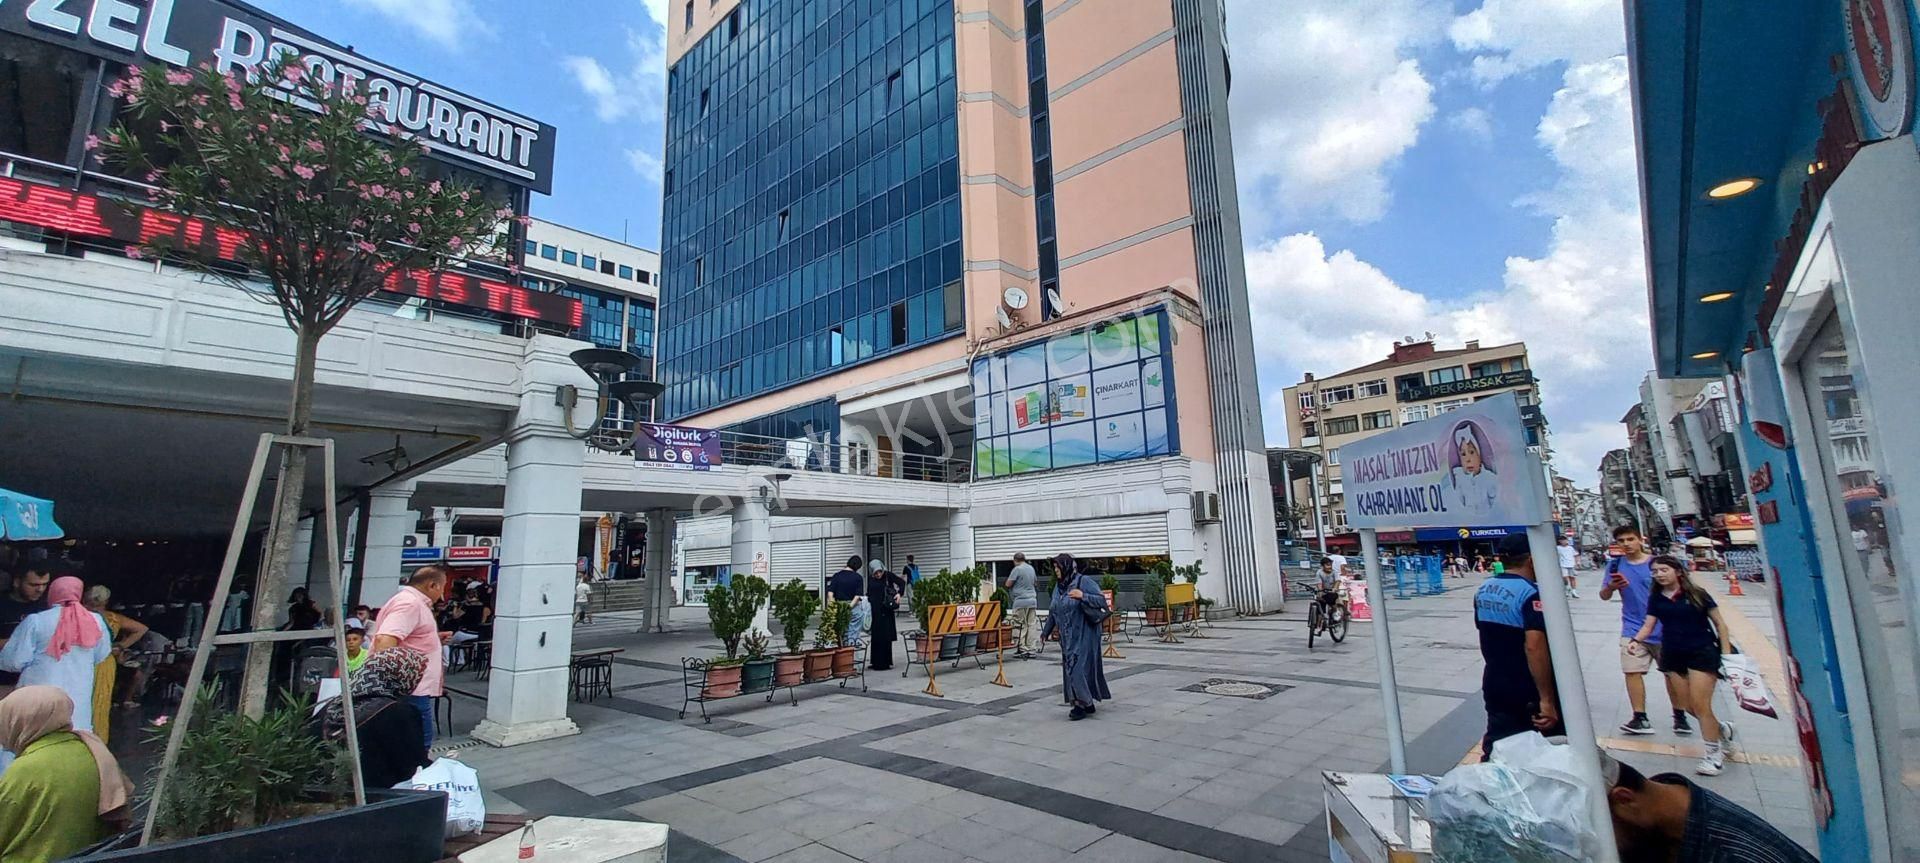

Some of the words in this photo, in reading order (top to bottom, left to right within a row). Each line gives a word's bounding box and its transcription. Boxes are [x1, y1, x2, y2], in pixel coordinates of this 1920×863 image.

[213, 17, 538, 167] RESTAURANT
[480, 281, 541, 318] TL
[1457, 376, 1504, 391] PARSAK
[1356, 486, 1427, 516] KAHRAMANI
[1428, 484, 1448, 513] OL
[1470, 529, 1508, 537] TURKCELL
